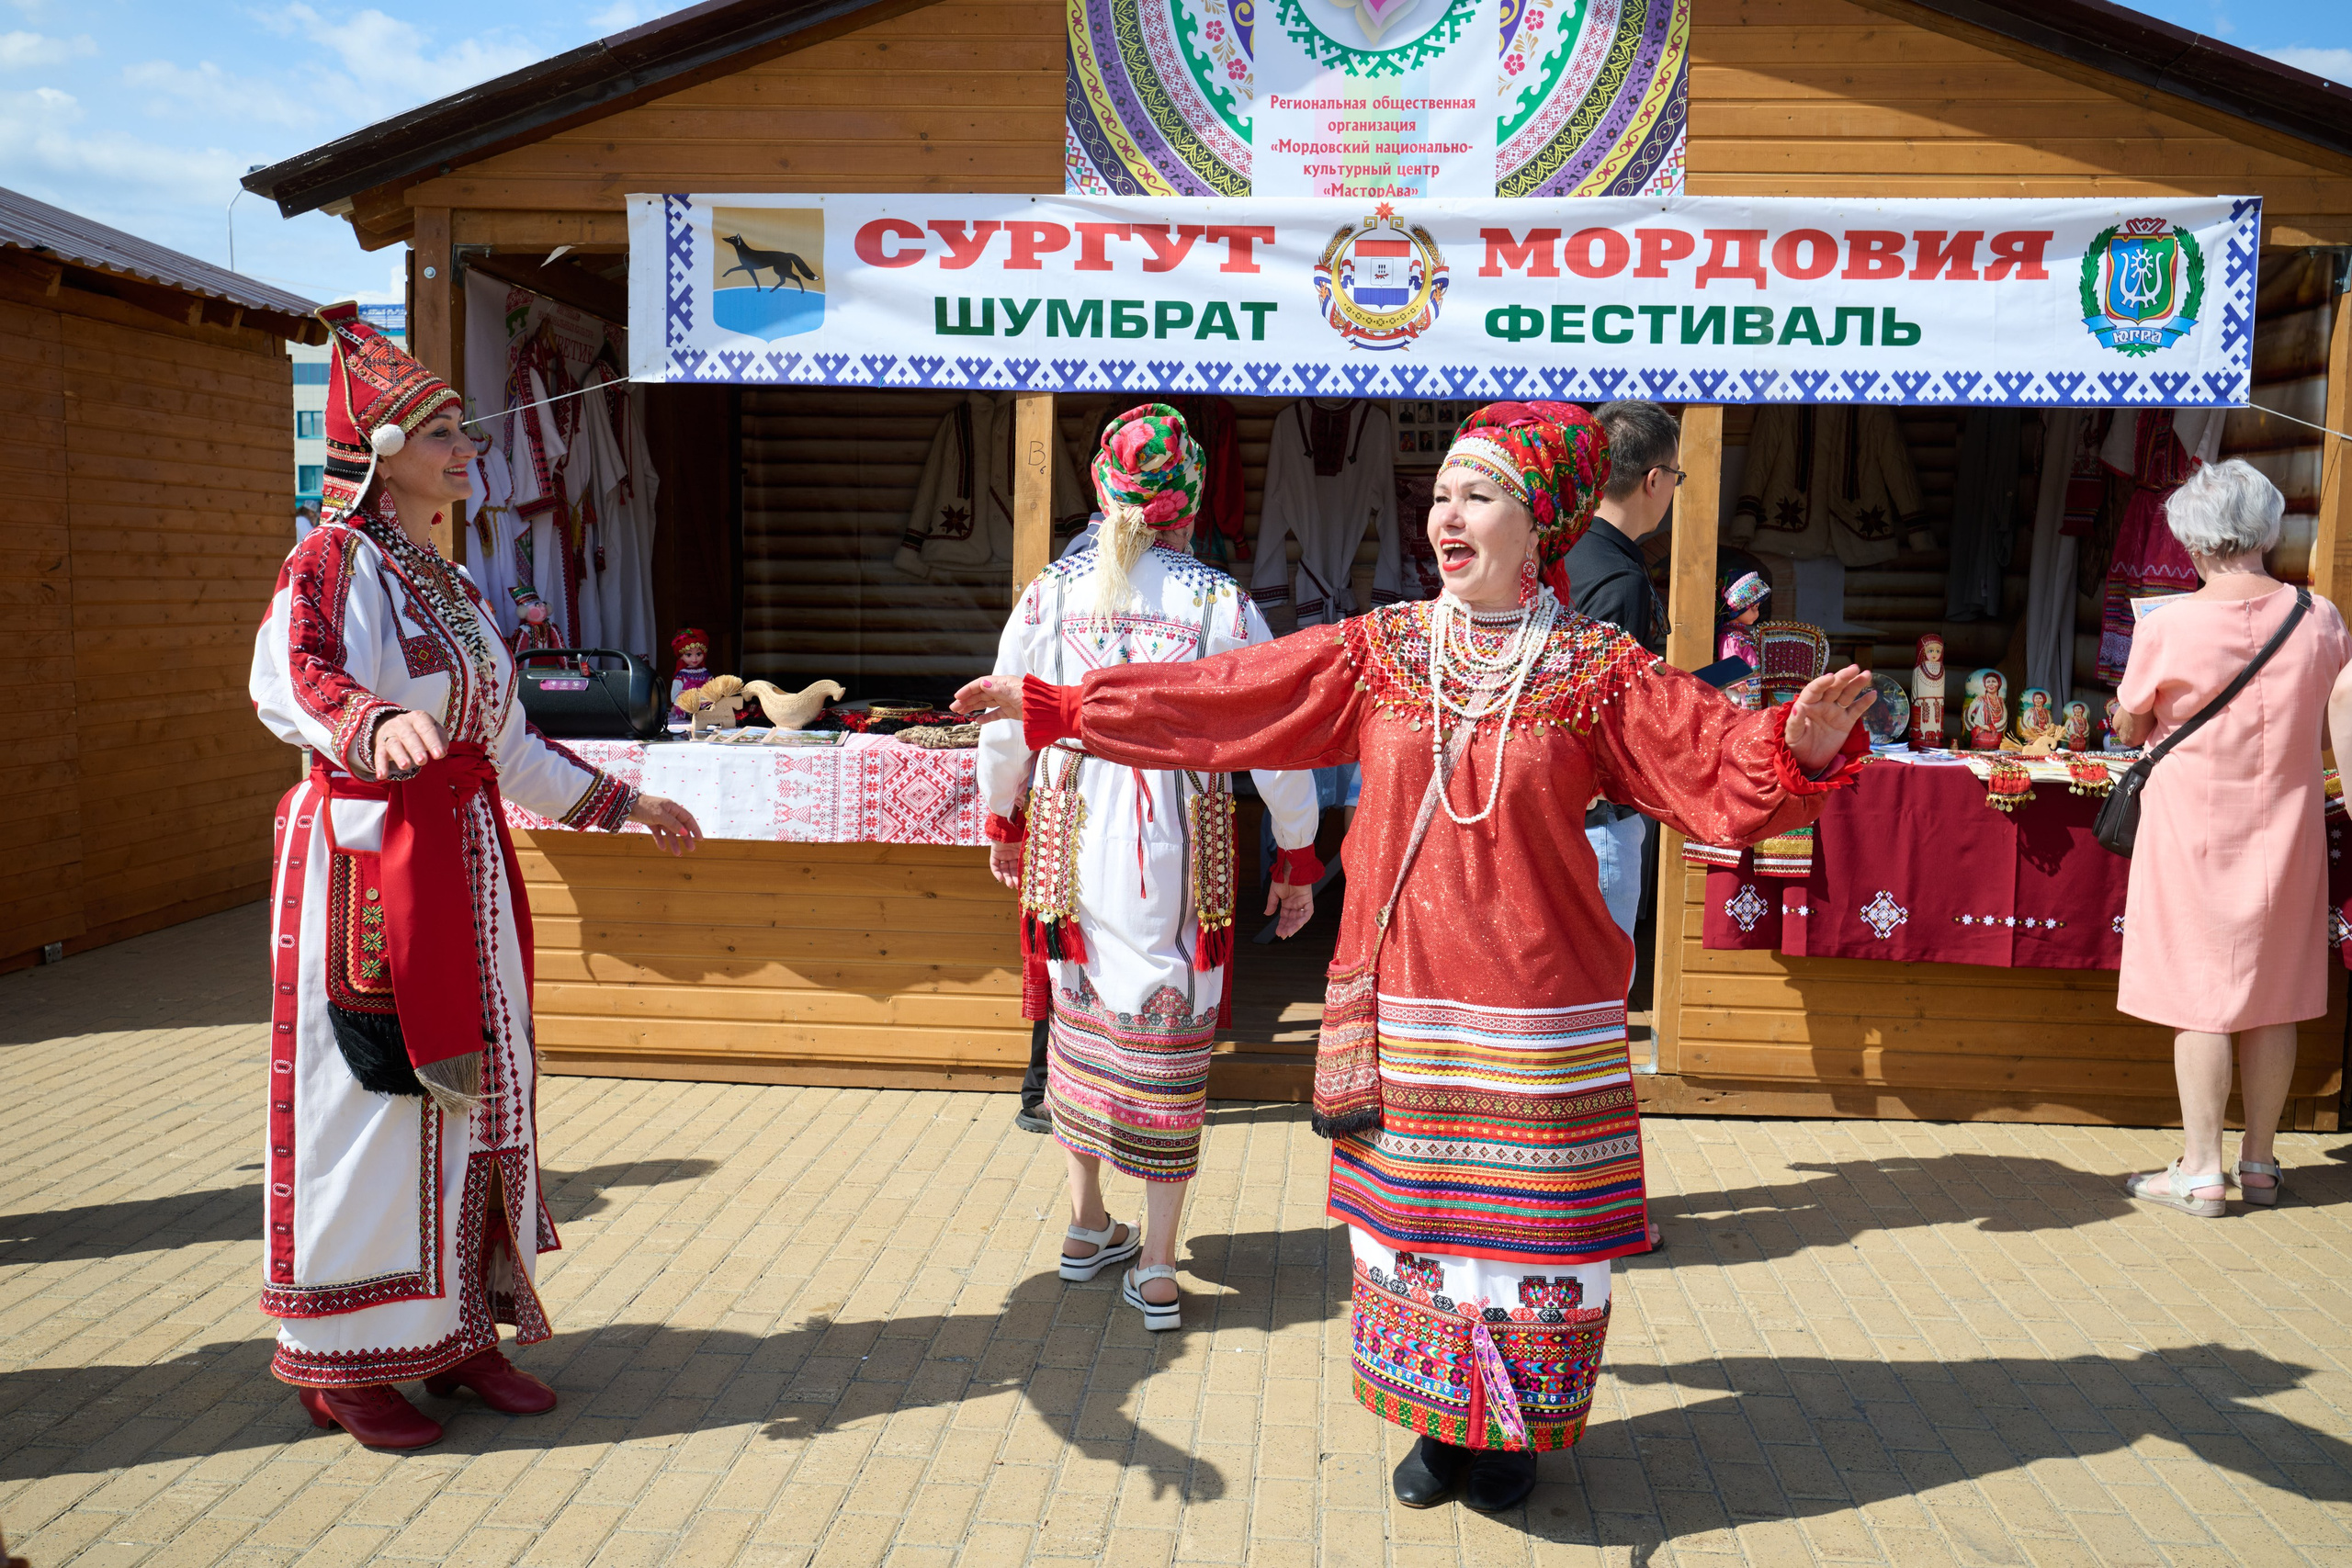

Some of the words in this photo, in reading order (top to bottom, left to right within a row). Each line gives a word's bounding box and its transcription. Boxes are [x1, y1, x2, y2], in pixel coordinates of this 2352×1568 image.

[1270, 95, 1367, 110] Региональная
[1373, 96, 1476, 111] общественная
[1328, 120, 1417, 135] организация
[1271, 139, 1370, 155] «Мордовский
[1375, 142, 1474, 155] национально-
[1303, 163, 1391, 177] культурный
[1396, 165, 1441, 178] центр
[1323, 183, 1419, 197] «МасторАва»
[854, 218, 1275, 274] СУРГУТ
[1478, 227, 2054, 290] МОРДОВИЯ
[934, 296, 1278, 341] ШУМБРАТ
[1485, 304, 1922, 346] ФЕСТИВАЛЬ
